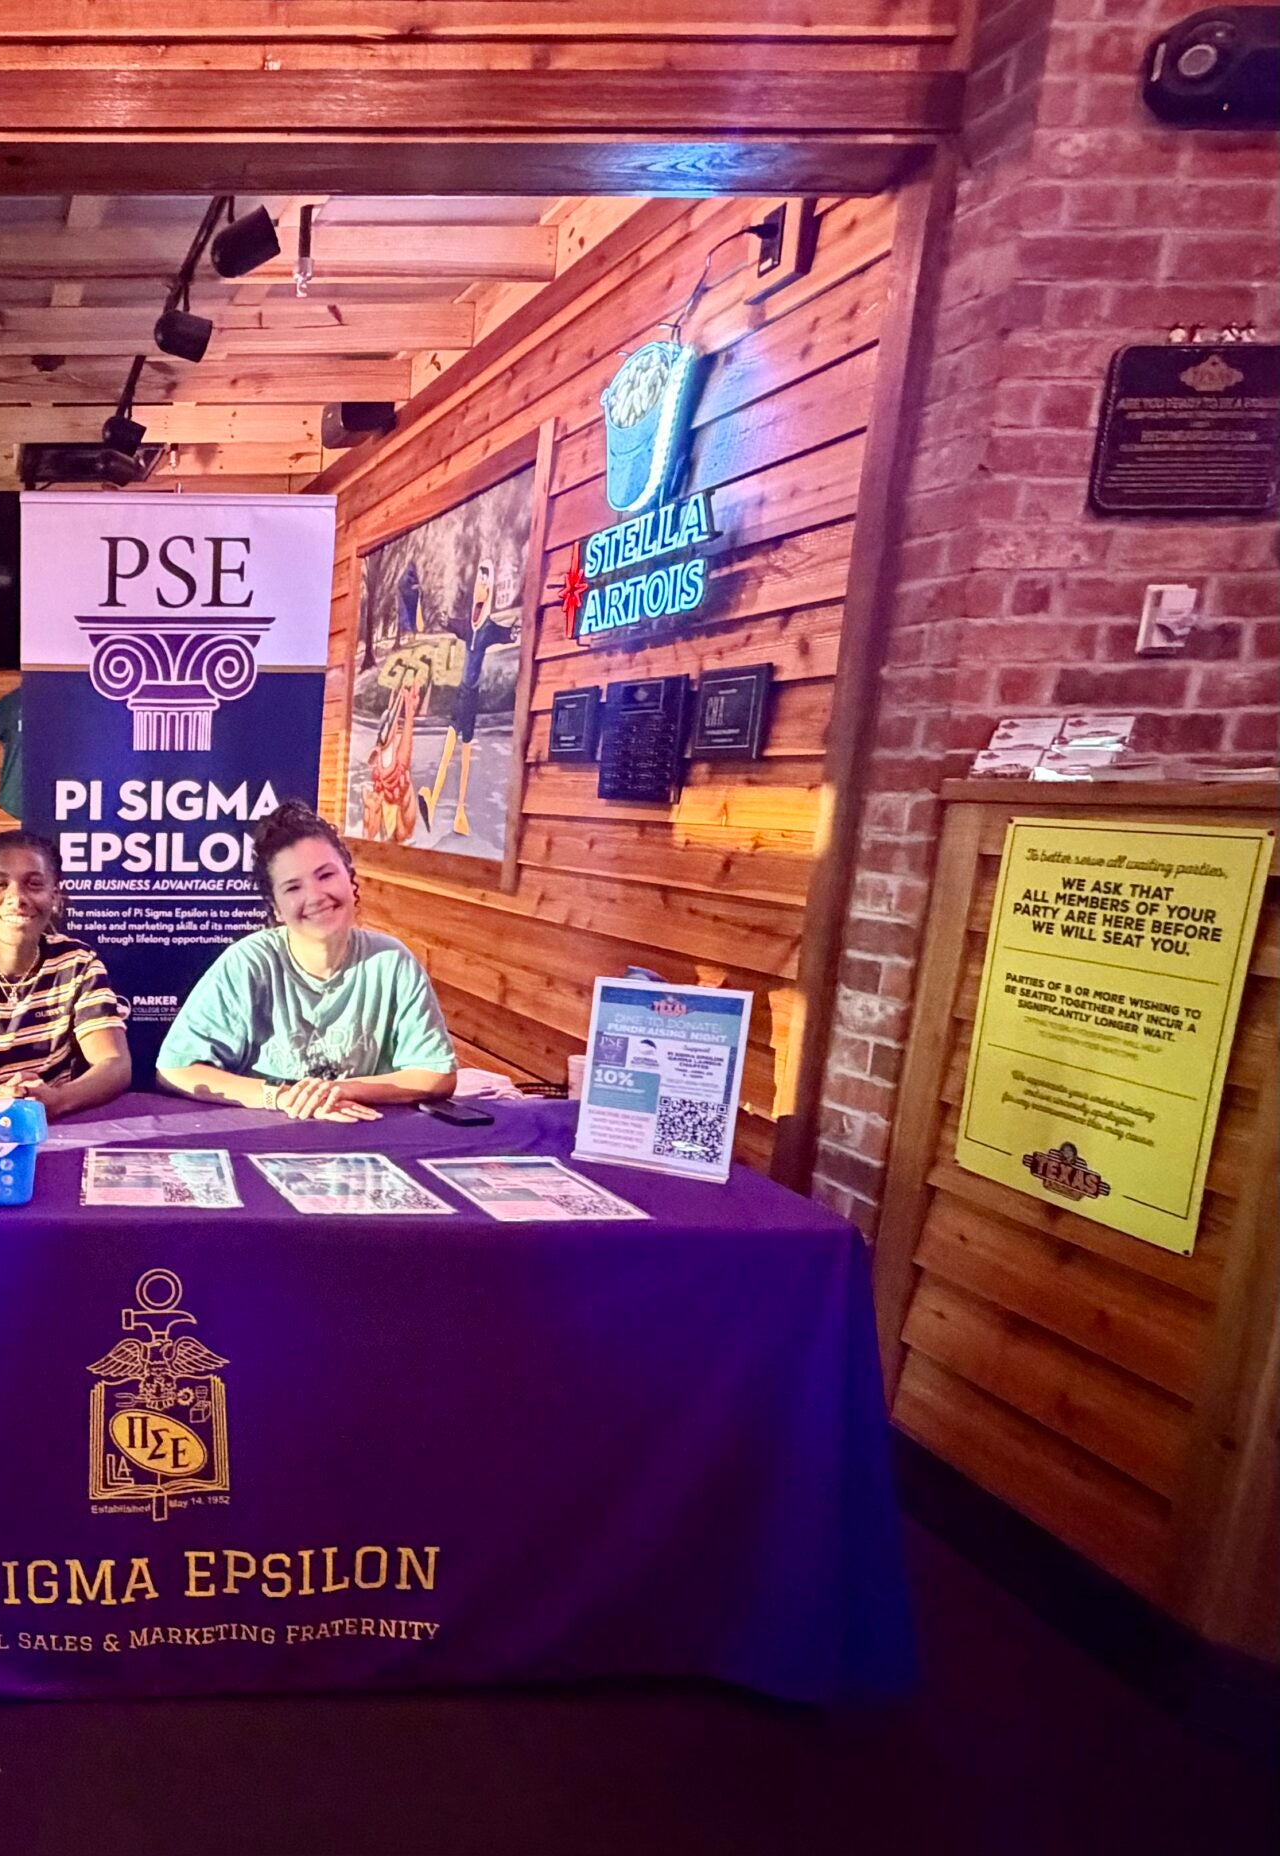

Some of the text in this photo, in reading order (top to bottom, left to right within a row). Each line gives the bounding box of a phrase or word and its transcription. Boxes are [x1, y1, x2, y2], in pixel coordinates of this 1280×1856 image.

[584, 492, 709, 578] STELLA
[98, 536, 253, 608] PSE
[579, 559, 705, 635] ARTOIS
[377, 637, 467, 689] GSU
[55, 780, 280, 821] PI SIGMA
[1025, 848, 1039, 861] To
[1040, 850, 1072, 864] better
[1073, 856, 1105, 867] serve
[1106, 855, 1127, 868] all
[1126, 859, 1173, 878] waiting
[59, 880, 92, 891] YOUR
[94, 879, 150, 891] BUSINESS
[152, 879, 223, 891] ADVANTAGE
[1062, 877, 1174, 901] WE ASK THAT
[66, 907, 268, 921] The mission of Pi Sigma Epsilon is to develop
[1013, 903, 1223, 942] PARTY ARE HERE BEFORE
[1022, 889, 1217, 923] ALL MEMBERS OF YOUR
[67, 921, 83, 931] the
[84, 921, 107, 931] sales
[109, 921, 126, 931] and
[128, 921, 174, 933] marketing
[176, 921, 198, 931] skills
[199, 921, 210, 931] of
[211, 921, 221, 931] its
[97, 934, 134, 946] through
[136, 934, 170, 946] lifelong
[1033, 920, 1190, 956] WE WILL SEAT YOU.
[133, 996, 177, 1006] PARKER
[1004, 984, 1197, 1034] BE SEATED TOGETHER MAY INCUR A
[1005, 972, 1045, 989] PARTIES
[1048, 981, 1063, 991] OF
[1075, 986, 1090, 998] OR
[1093, 990, 1126, 1005] MORE
[1129, 994, 1180, 1016] WISHING
[1184, 1007, 1202, 1020] TO
[607, 1022, 728, 1045] FUNDRAISING NIGHT
[1018, 1000, 1175, 1042] SIGNIFICANTLY LONGER WAIT.
[600, 1035, 625, 1048] PSE
[593, 1068, 634, 1087] 10%
[1033, 1154, 1100, 1195] TEXAS
[91, 1504, 151, 1514] Established
[169, 1500, 188, 1509] May
[207, 1496, 231, 1505] 1952
[184, 1546, 441, 1599] EPSILON
[18, 1632, 93, 1652] SALES
[103, 1633, 121, 1652] &
[129, 1623, 276, 1649] MARKETING
[286, 1617, 441, 1646] FRATERNITY
